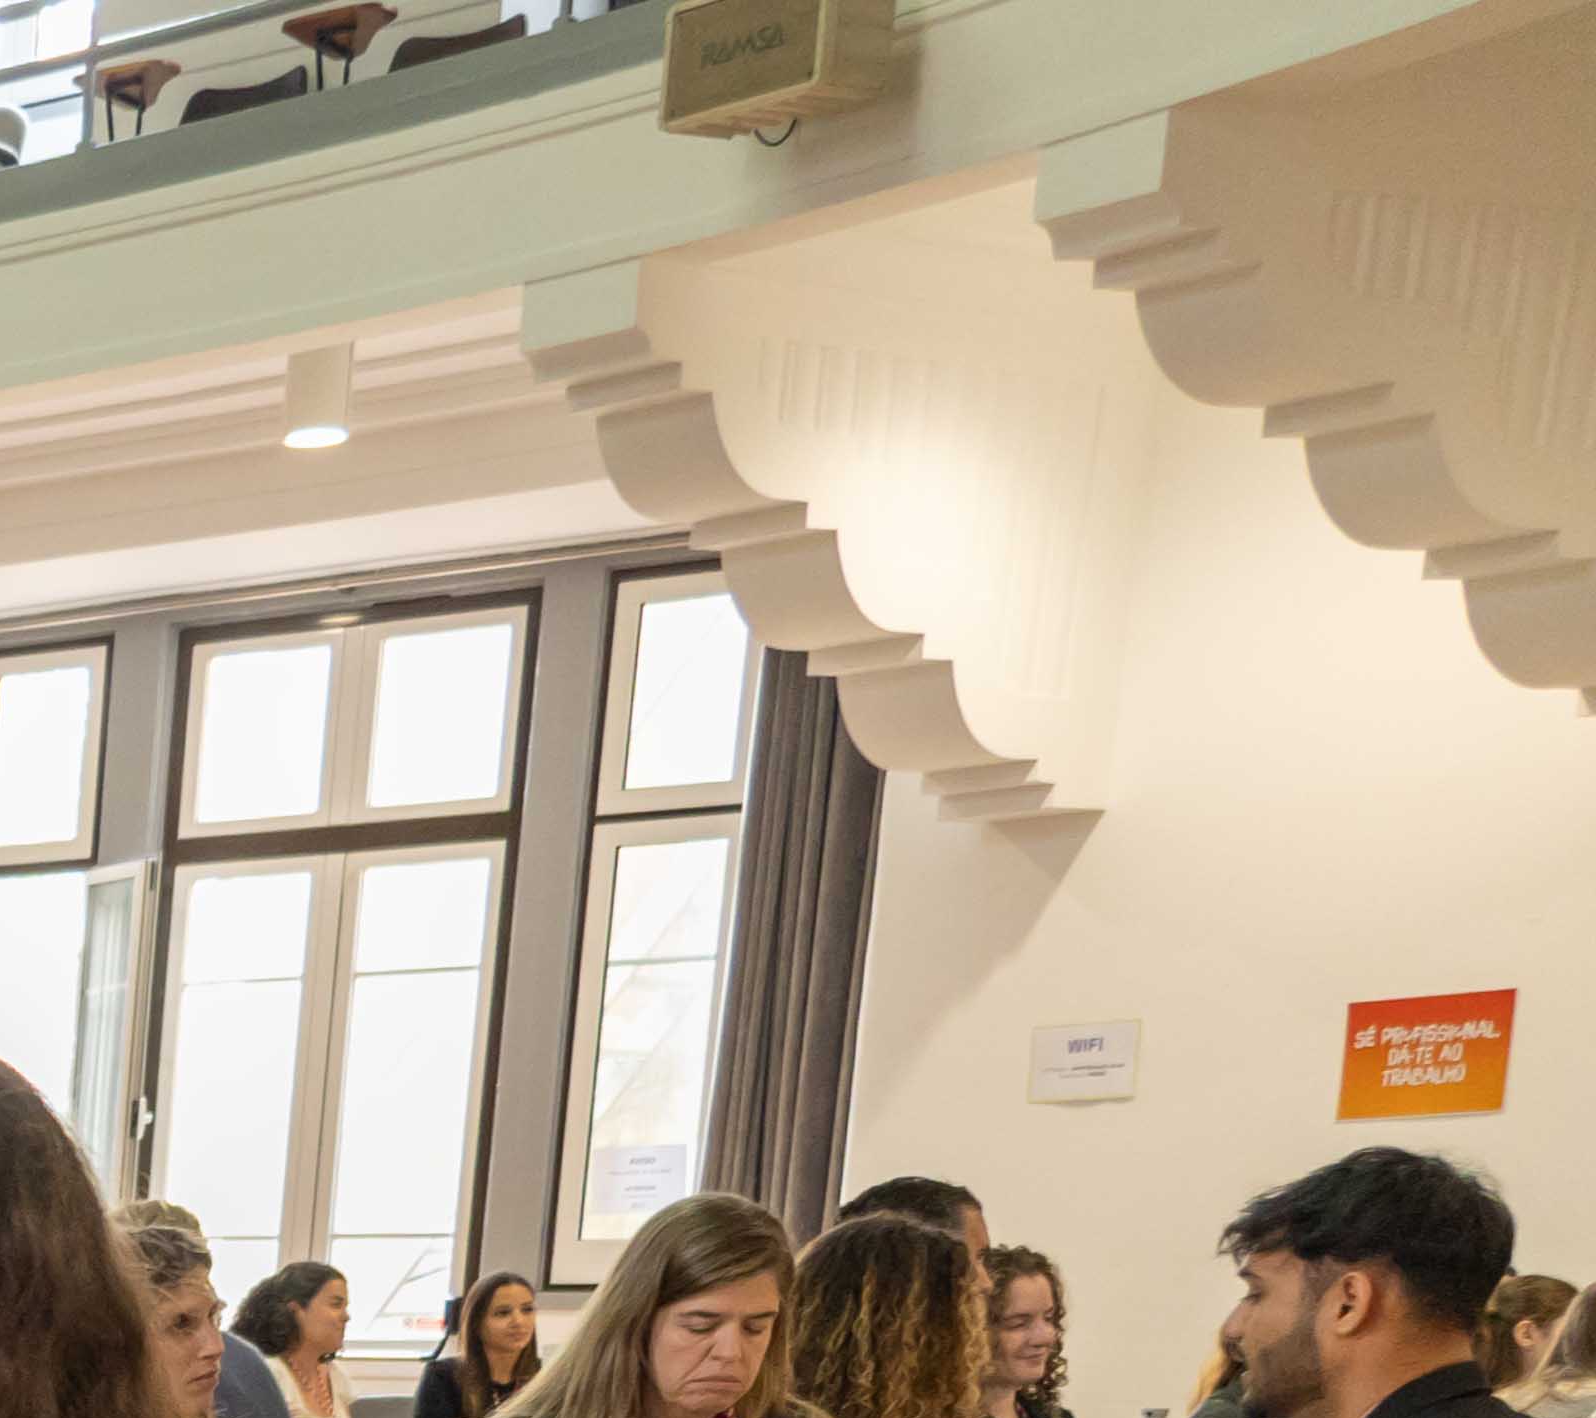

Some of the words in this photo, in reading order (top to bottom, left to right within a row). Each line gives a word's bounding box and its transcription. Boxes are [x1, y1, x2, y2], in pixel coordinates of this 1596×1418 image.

[1353, 1025, 1377, 1049] SÉ
[1387, 1045, 1433, 1066] DÁ-TE
[1438, 1043, 1464, 1061] AO
[1381, 1064, 1467, 1087] TRABALHO
